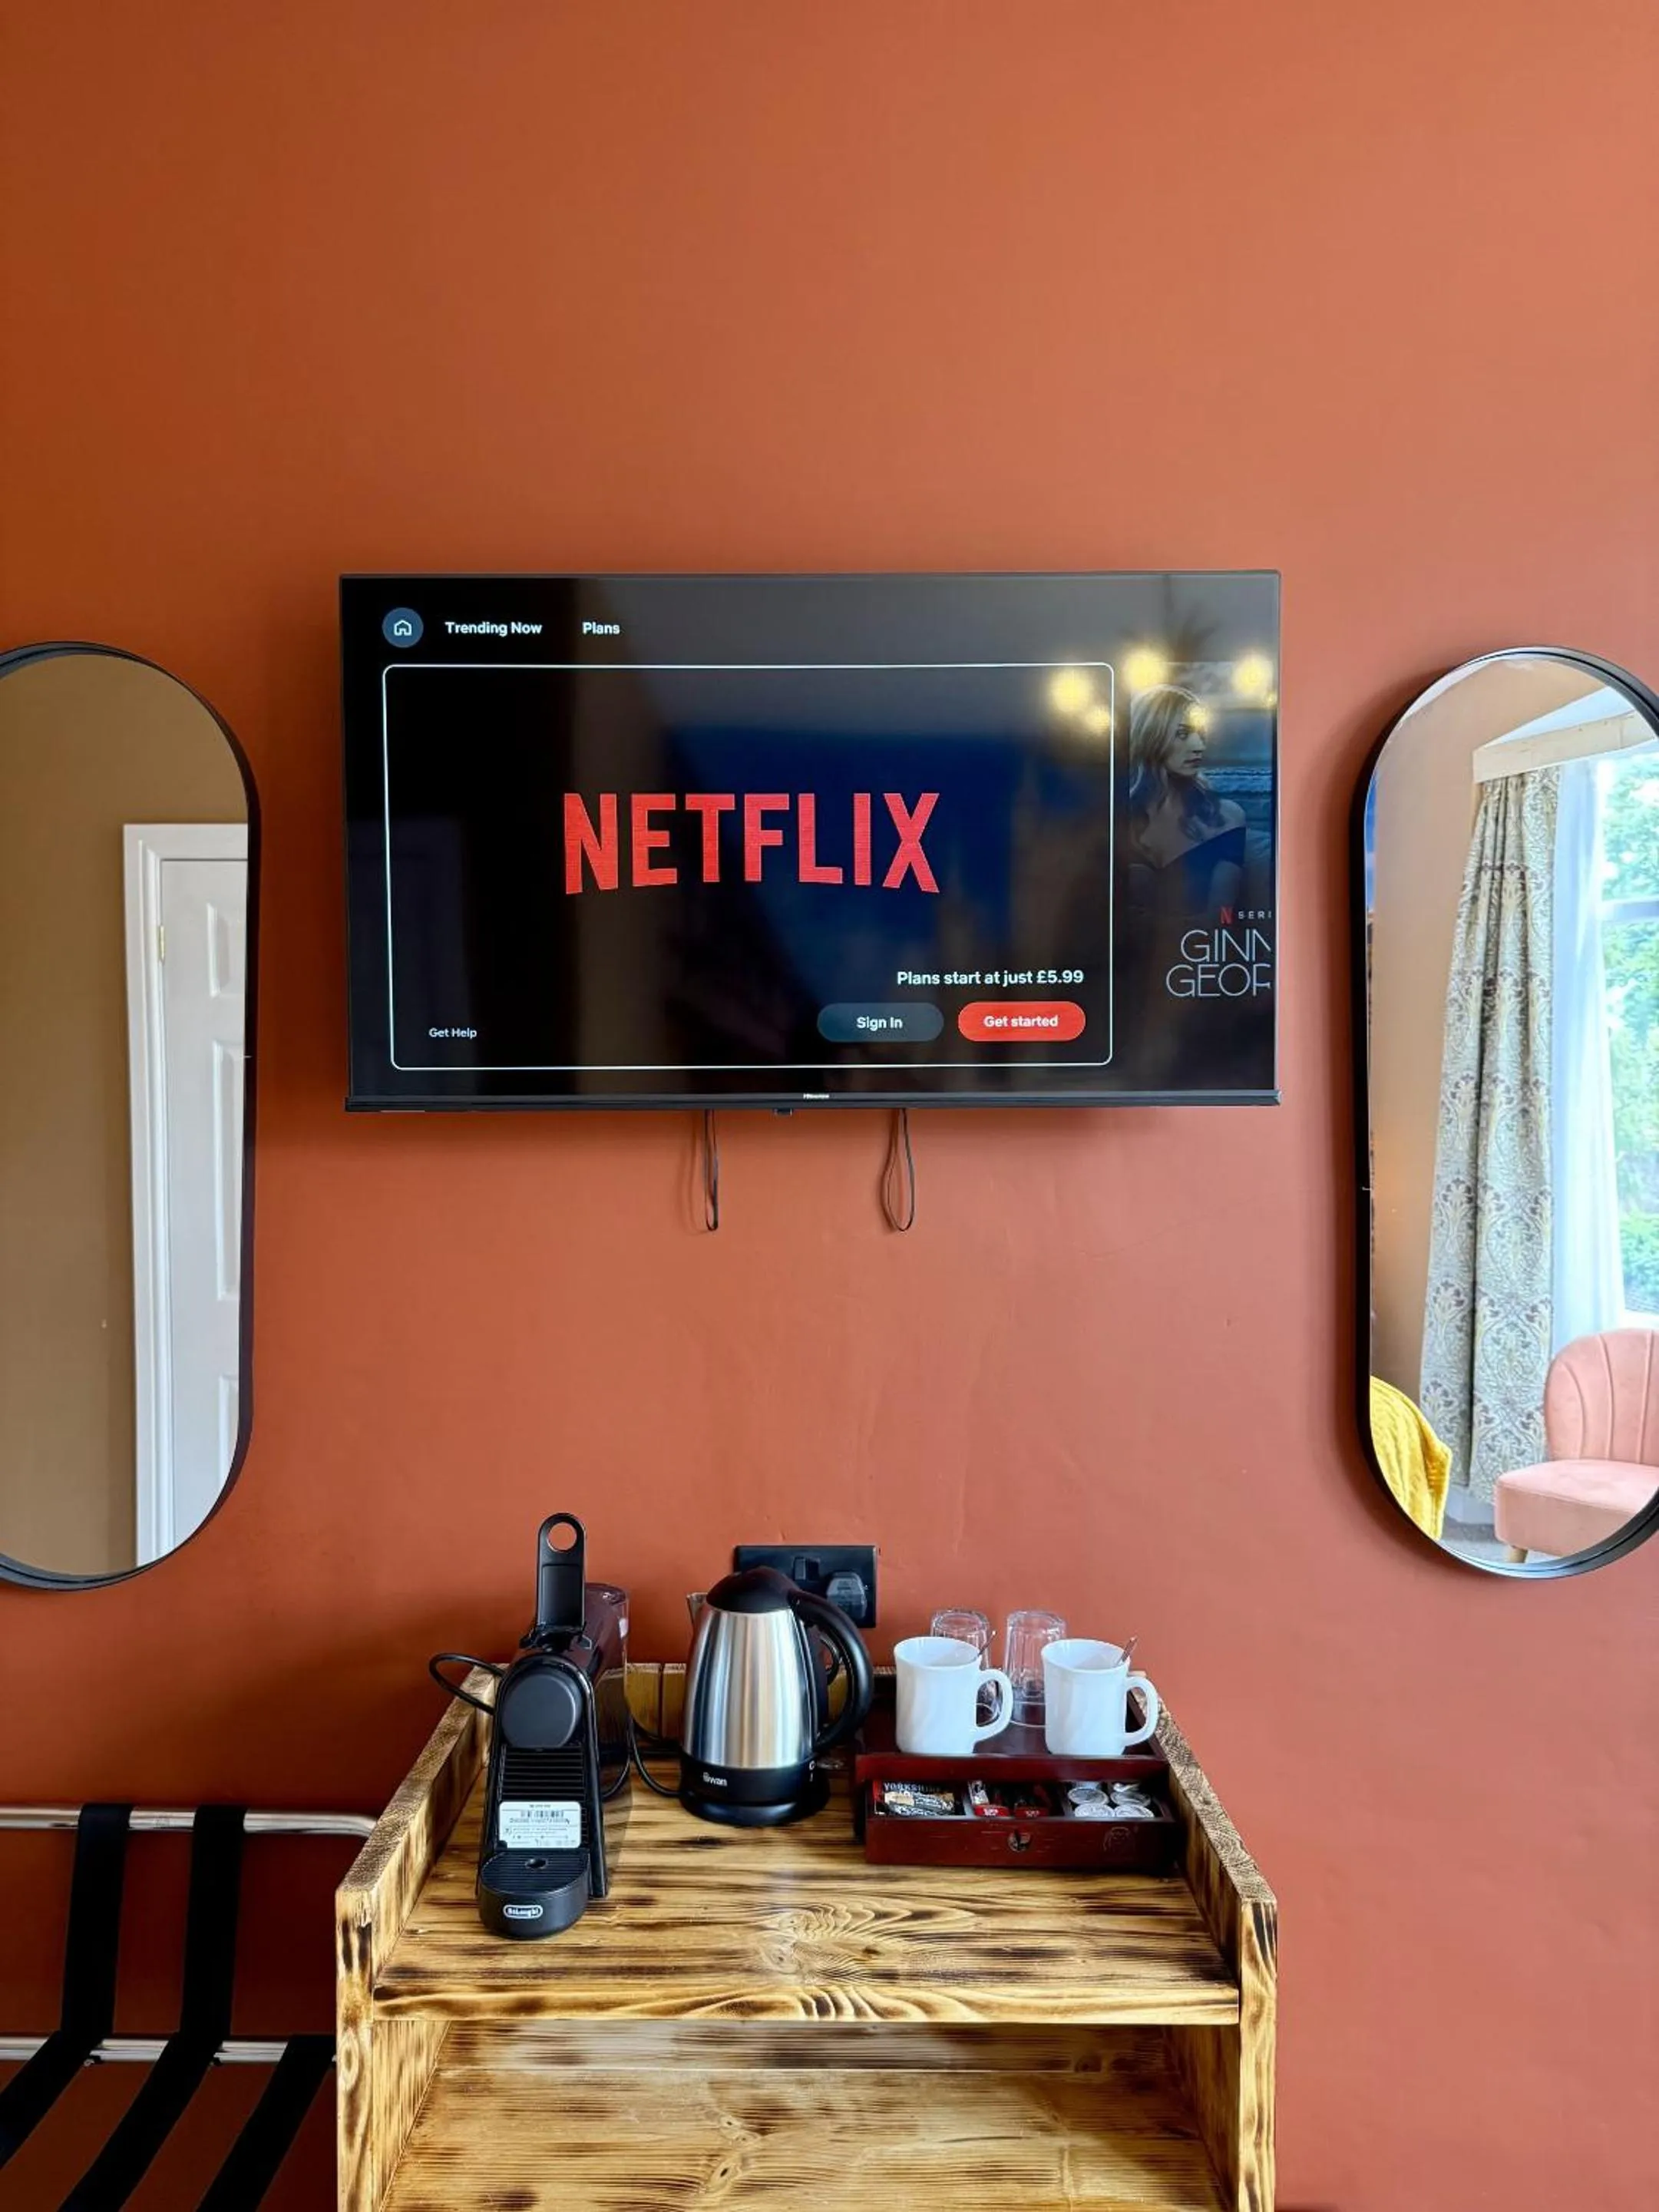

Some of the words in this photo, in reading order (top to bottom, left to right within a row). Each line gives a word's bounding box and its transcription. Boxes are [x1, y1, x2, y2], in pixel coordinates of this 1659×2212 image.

[444, 621, 508, 637] Trending
[511, 621, 544, 634] Now
[583, 621, 620, 634] Plans
[563, 792, 939, 894] NETFLIX
[897, 971, 940, 985] Plans
[944, 971, 981, 985] start
[984, 971, 1000, 984] at
[1001, 970, 1033, 987] just
[1036, 970, 1085, 984] £5.99
[856, 1015, 887, 1032] Sign
[890, 1016, 904, 1029] In
[983, 1015, 1008, 1027] Get
[1010, 1015, 1059, 1027] started
[428, 1027, 450, 1038] Get
[451, 1027, 478, 1040] Help
